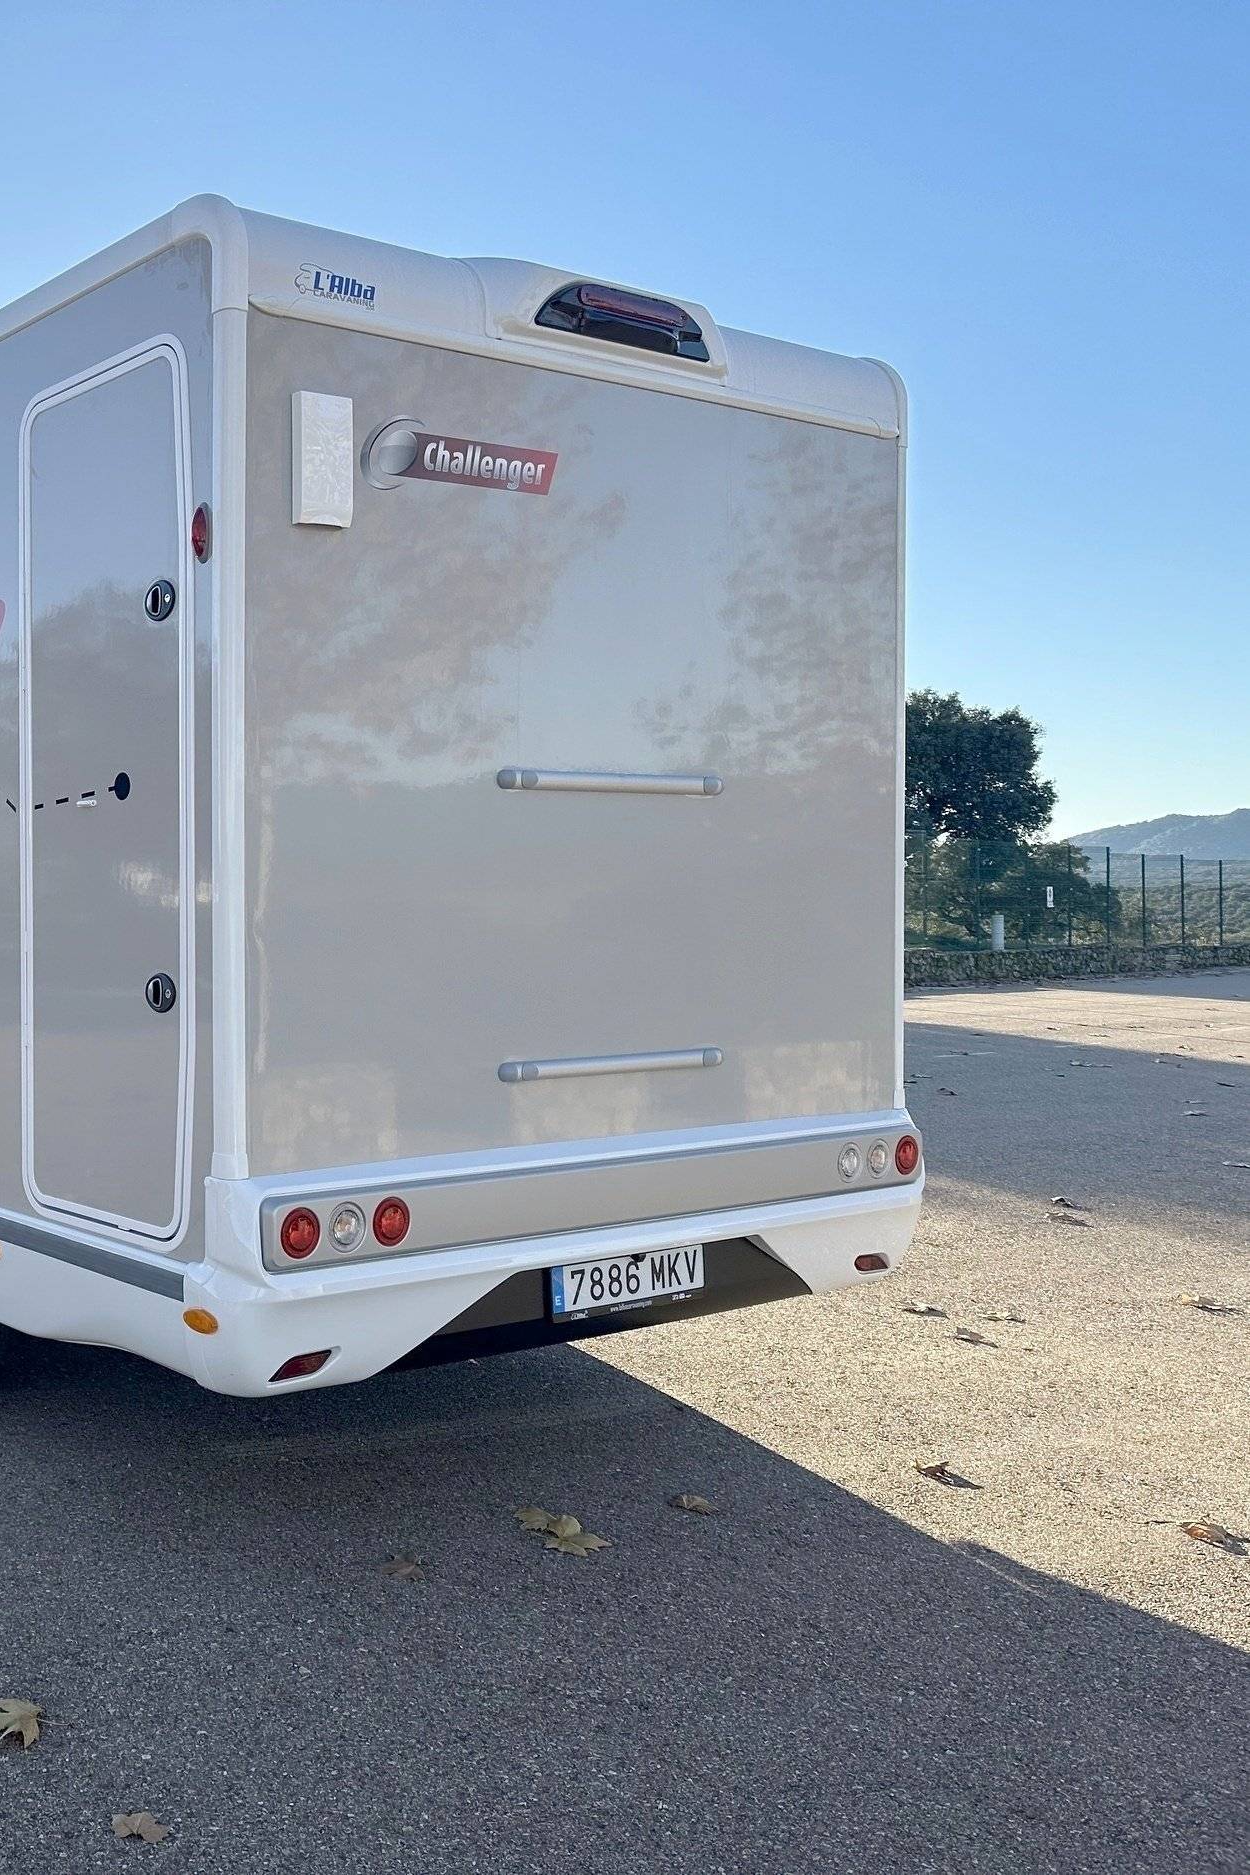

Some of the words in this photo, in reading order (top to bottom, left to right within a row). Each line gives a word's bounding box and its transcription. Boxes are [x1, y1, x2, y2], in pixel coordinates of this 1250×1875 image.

[313, 290, 375, 308] CARAVANING
[314, 271, 375, 300] L'Alba
[423, 440, 546, 490] Challenger
[570, 1260, 640, 1306] 7886
[650, 1249, 697, 1291] MKV
[554, 1295, 562, 1306] E
